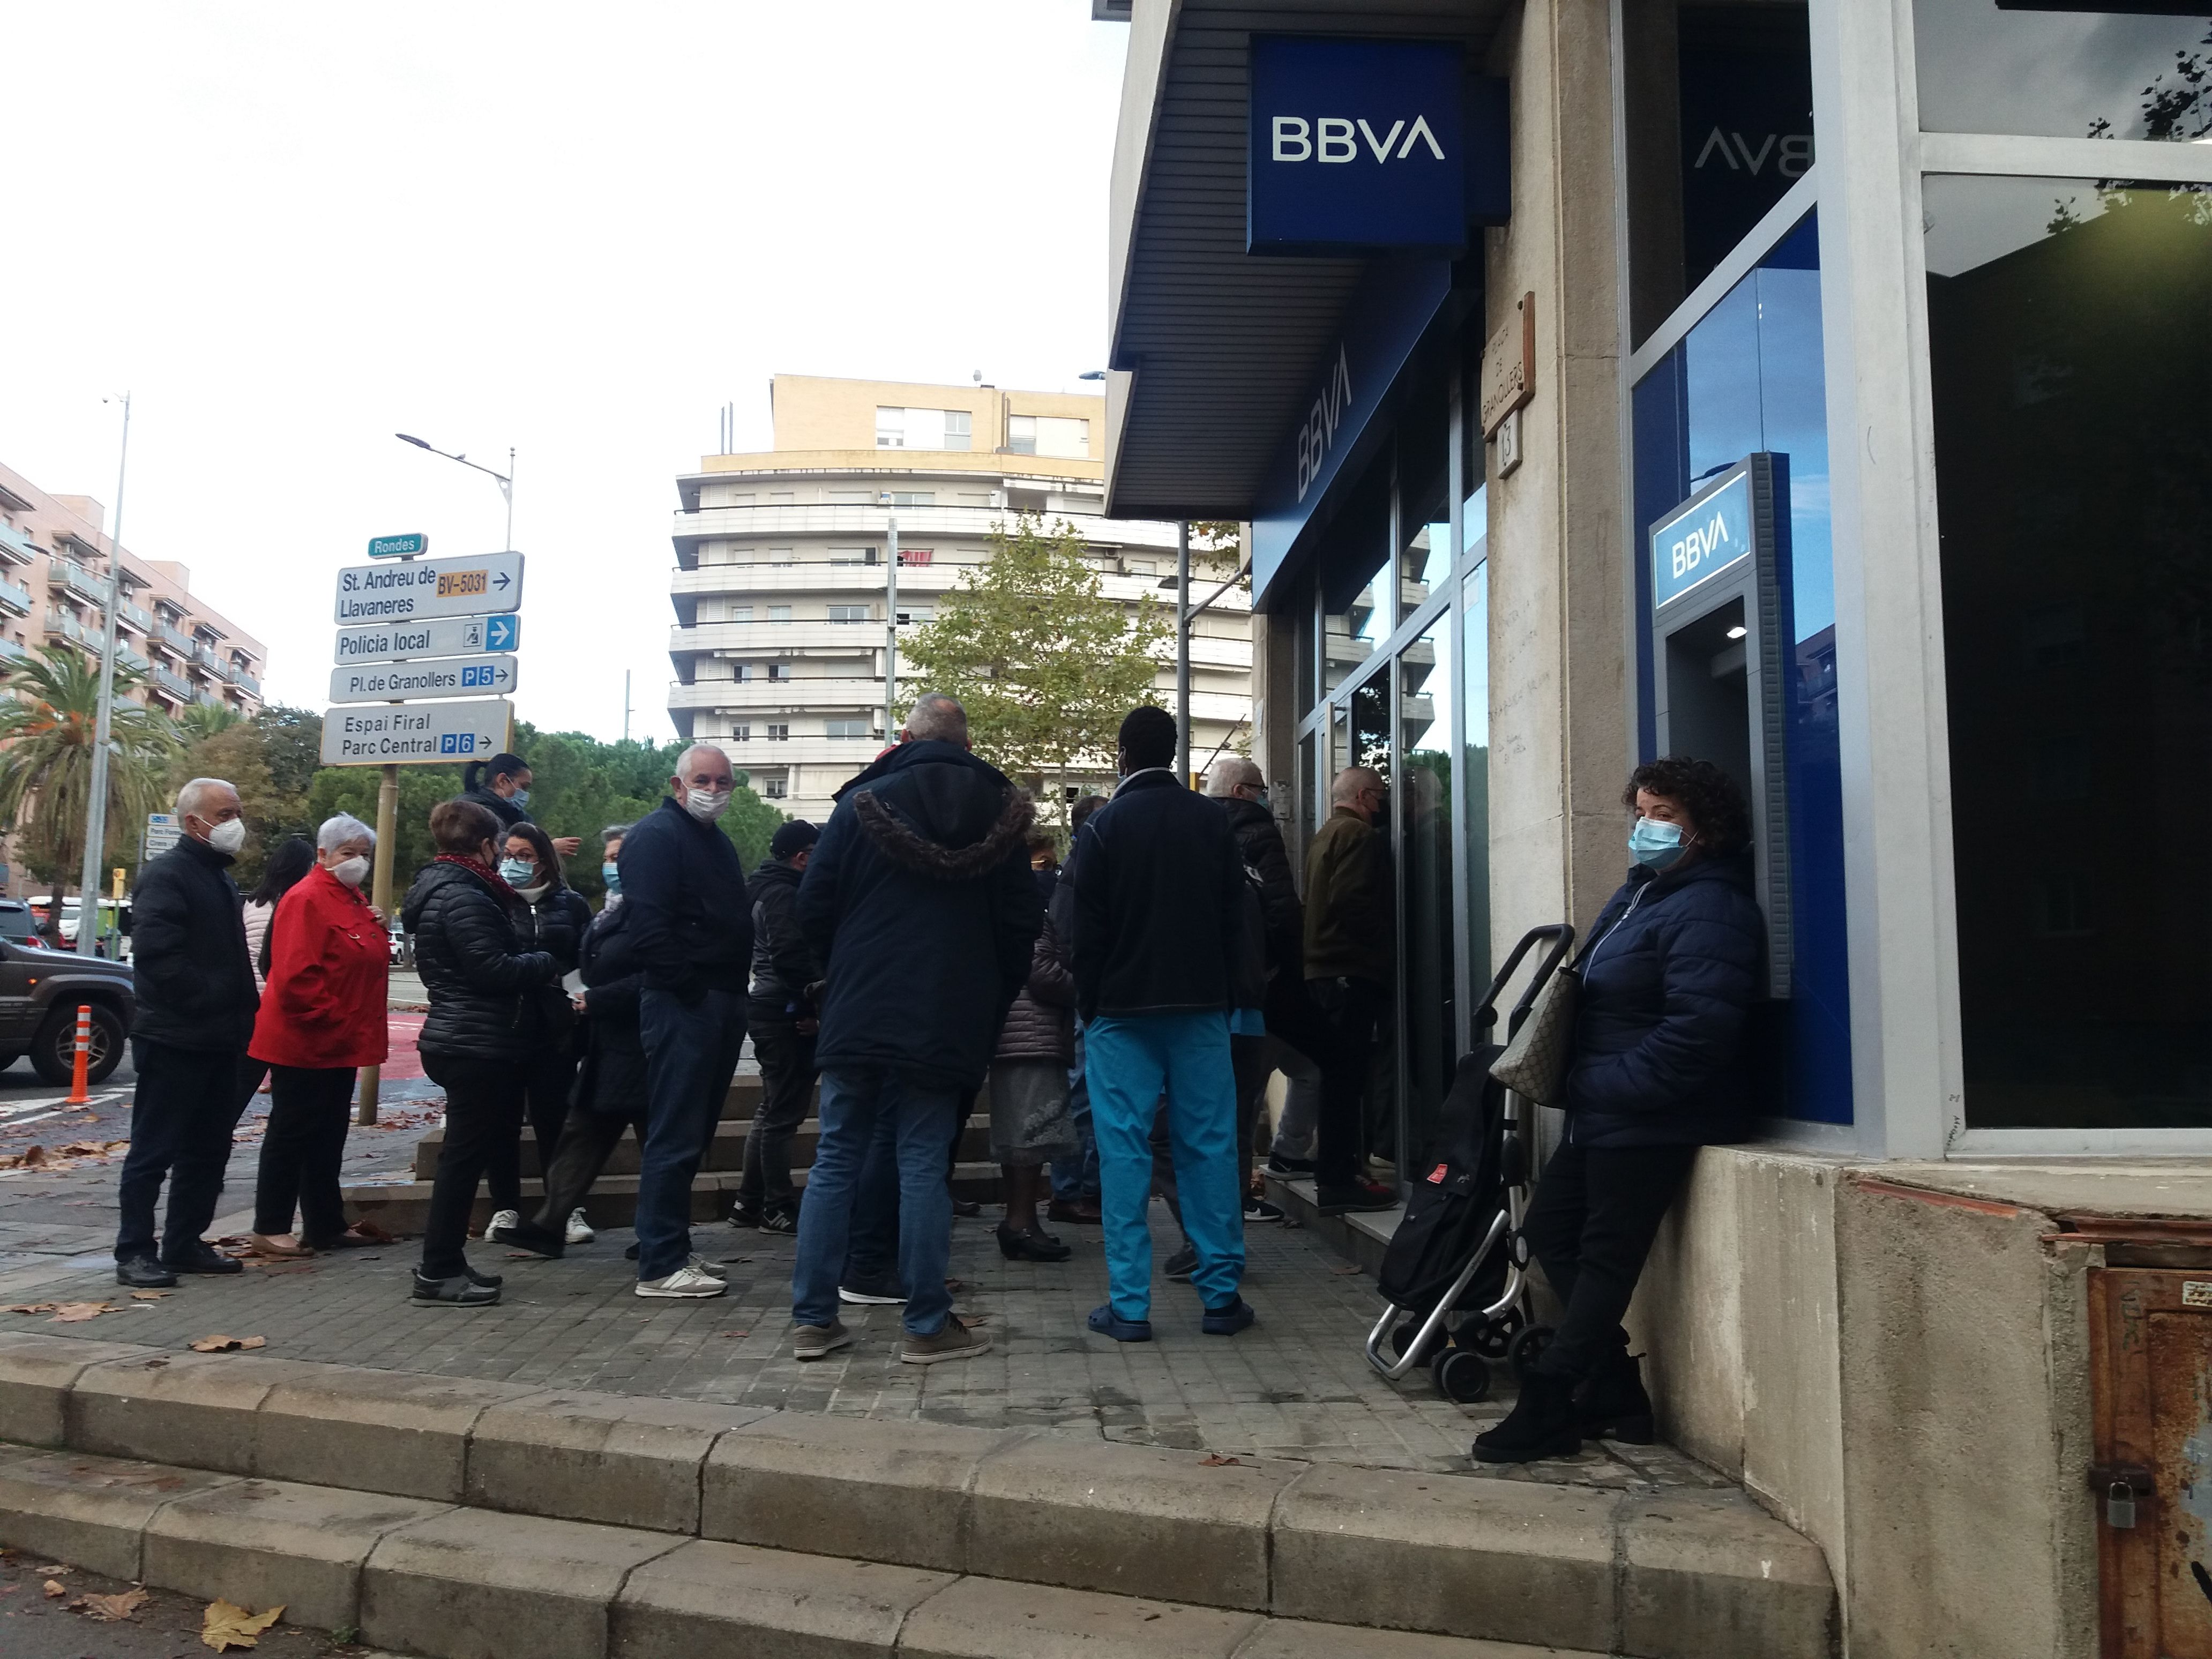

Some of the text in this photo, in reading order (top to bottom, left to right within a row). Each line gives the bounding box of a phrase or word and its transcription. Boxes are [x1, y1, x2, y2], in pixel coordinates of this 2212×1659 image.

[1272, 114, 1446, 165] BBVA
[1298, 341, 1352, 504] BBVA
[1501, 424, 1512, 462] 13
[374, 537, 415, 554] Rondes
[1672, 510, 1730, 579] BBVA
[342, 566, 437, 592] St. Andreu de
[437, 572, 487, 596] BV-5031
[340, 597, 415, 618] Llavaneres
[393, 629, 431, 651] local
[388, 671, 457, 690] Granollers
[345, 714, 430, 736] Espai Firal
[342, 736, 437, 756] Parc Central
